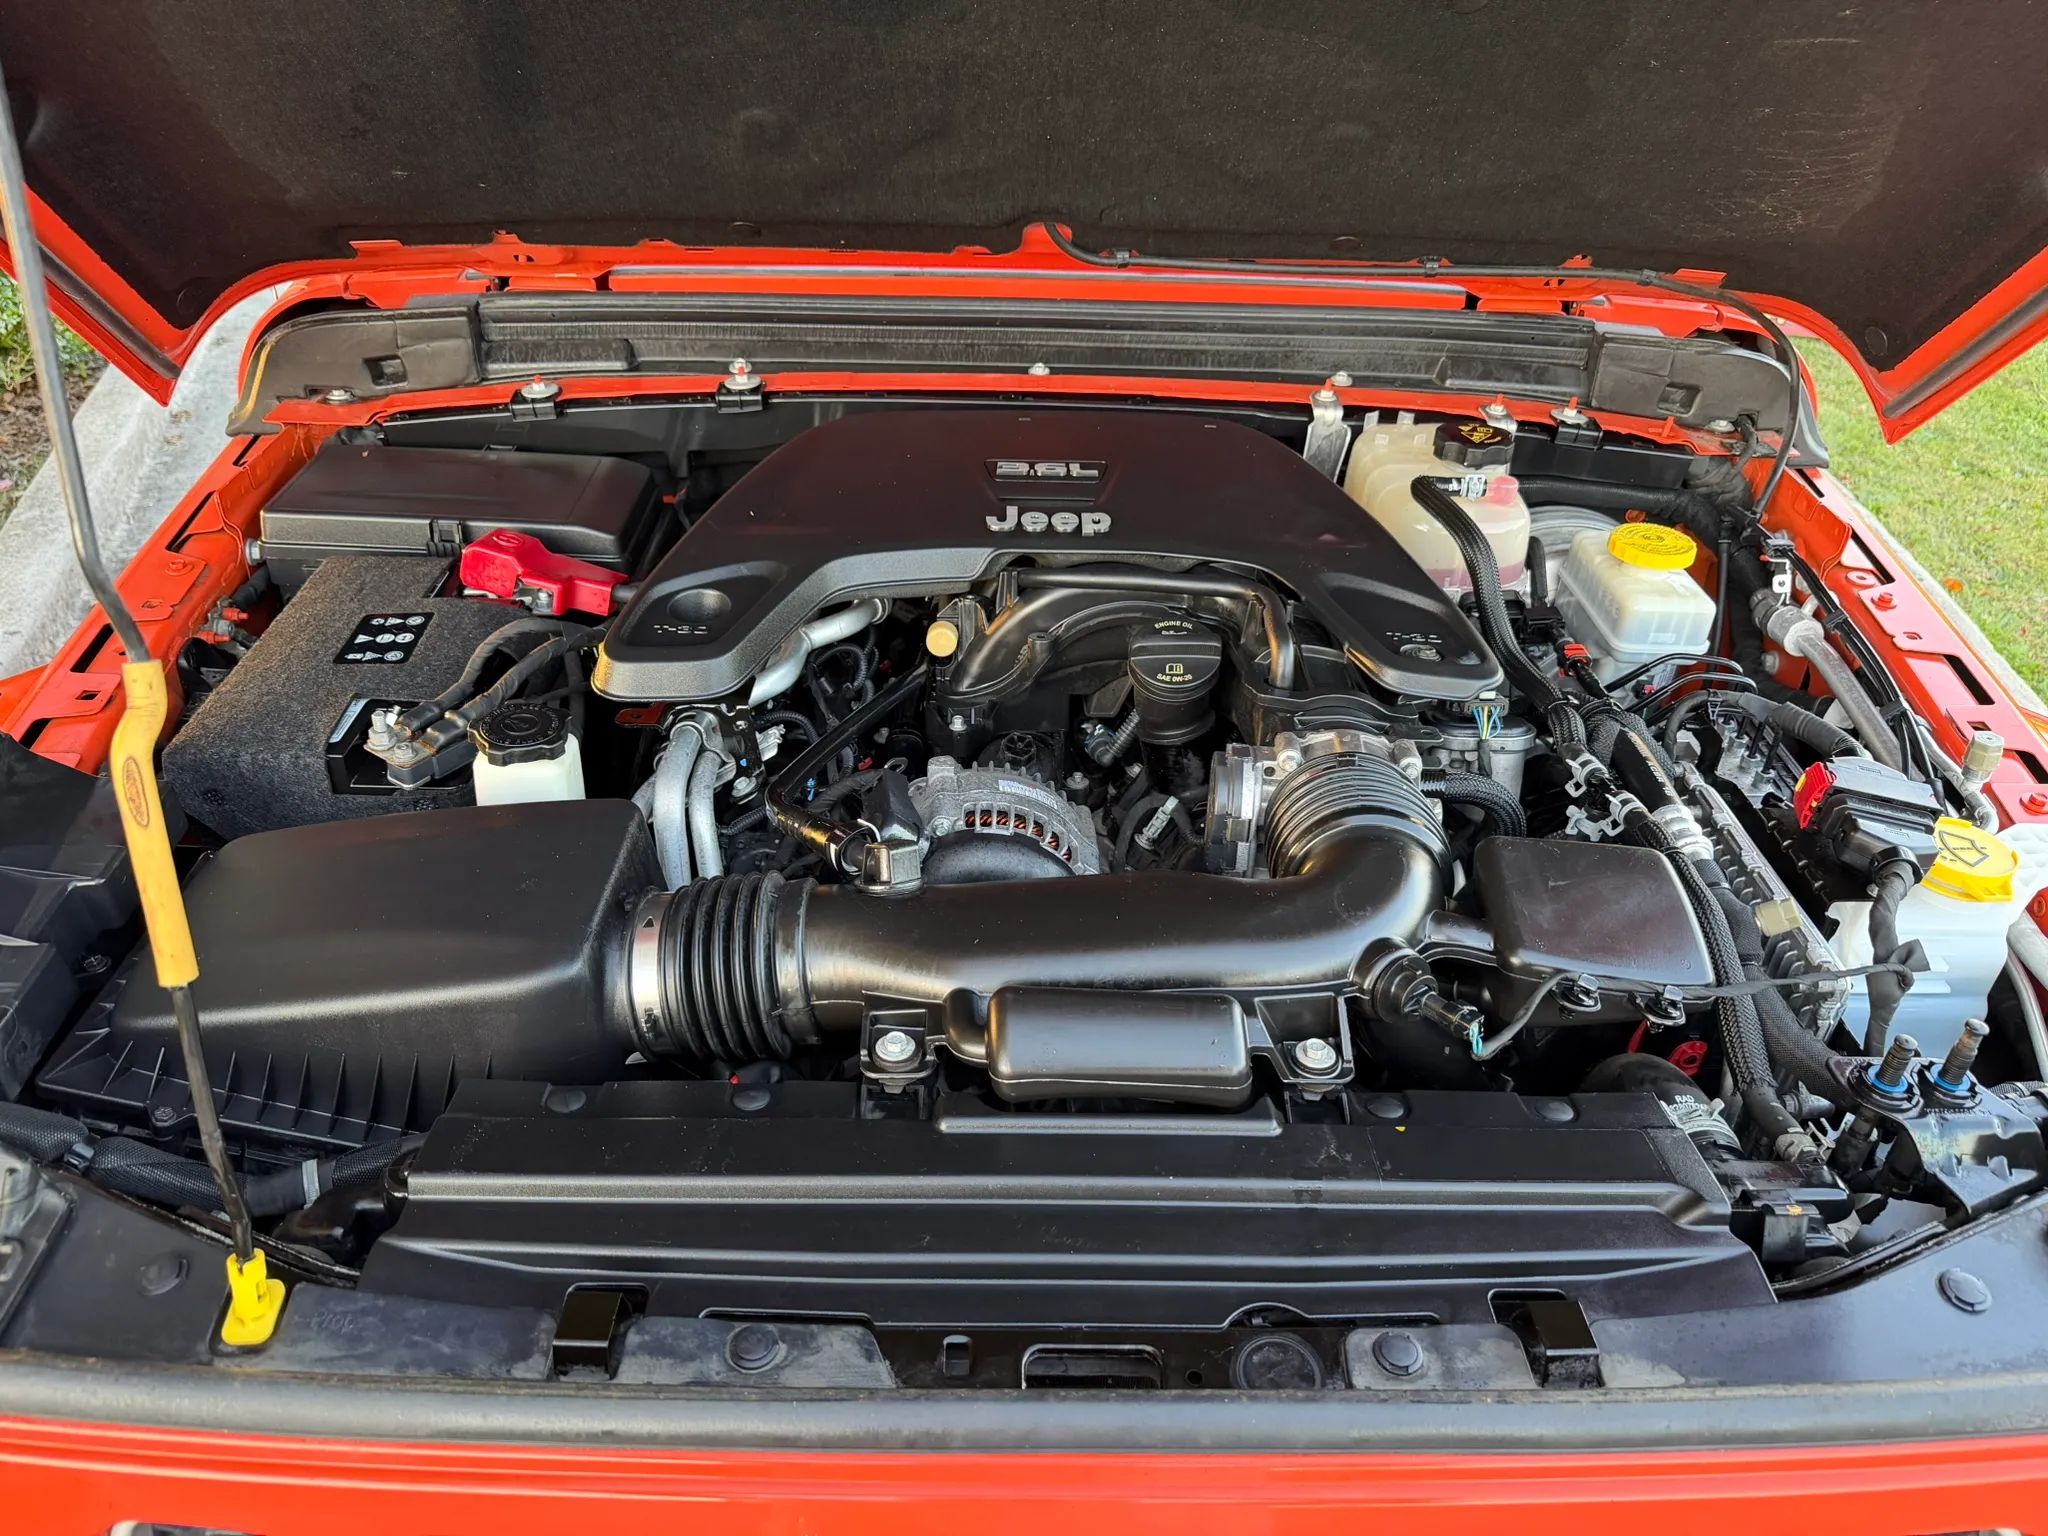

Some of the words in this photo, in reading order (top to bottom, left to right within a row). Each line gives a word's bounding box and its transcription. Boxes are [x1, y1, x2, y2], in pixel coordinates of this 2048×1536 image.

[985, 505, 1112, 536] Jeep
[1154, 620, 1181, 629] ENGINE
[1182, 621, 1193, 630] OIL
[1156, 673, 1171, 682] SAE
